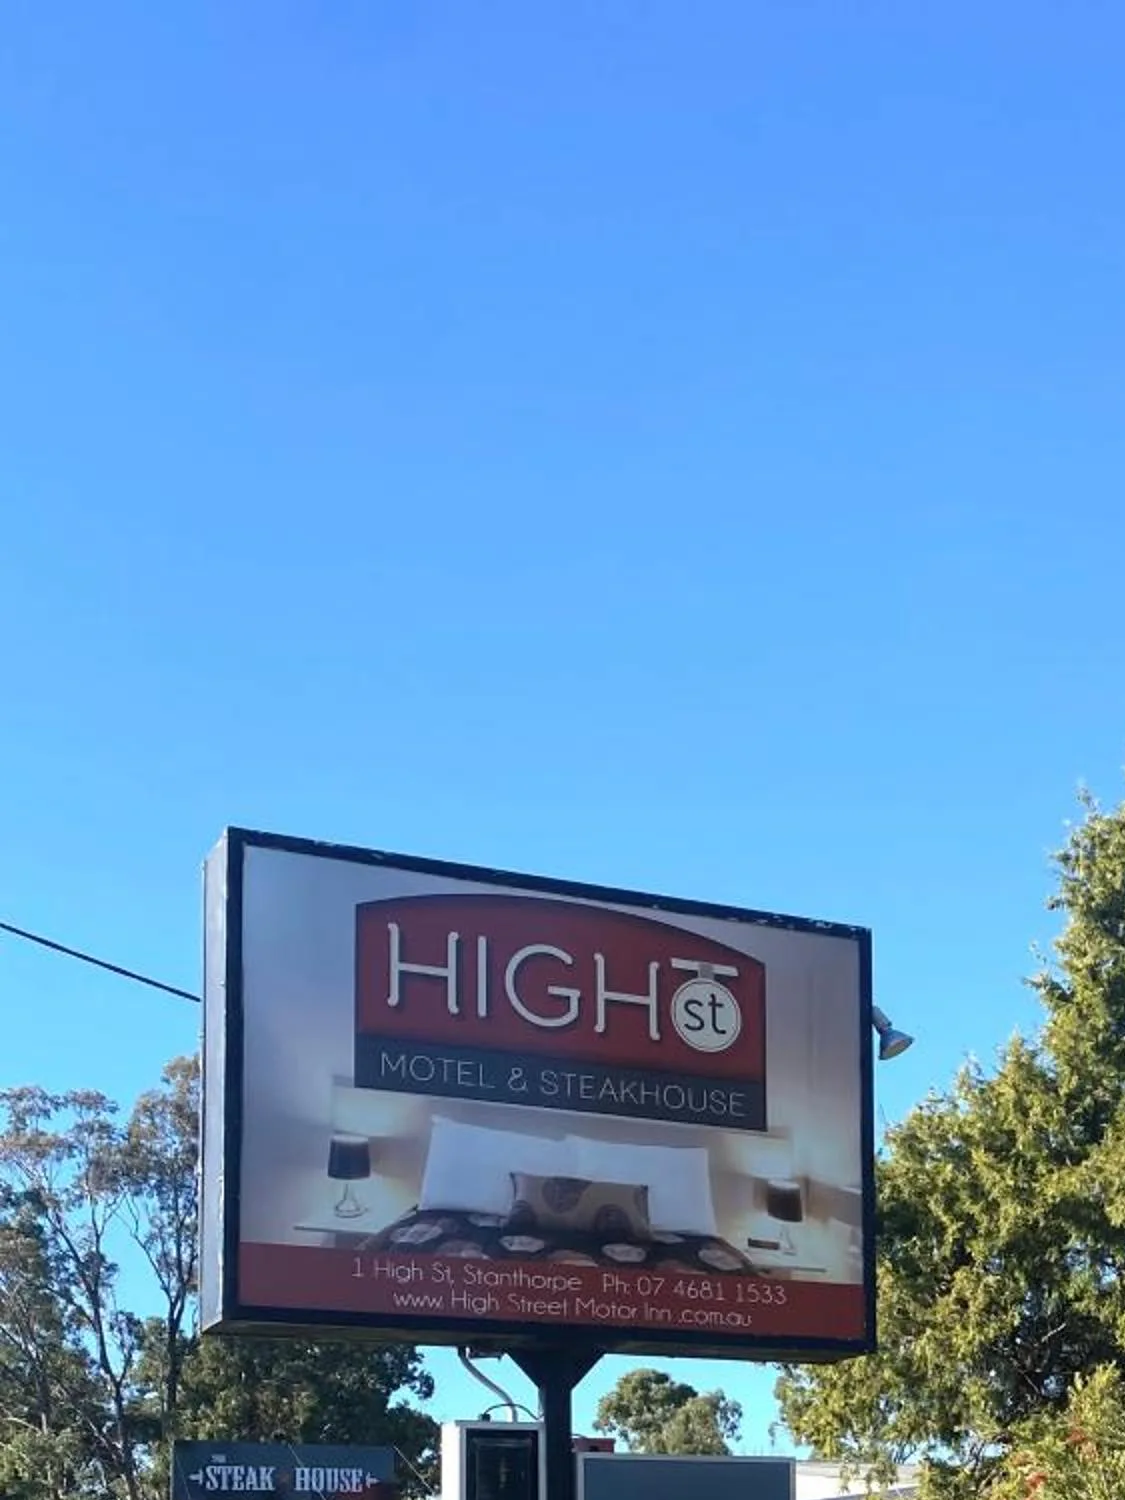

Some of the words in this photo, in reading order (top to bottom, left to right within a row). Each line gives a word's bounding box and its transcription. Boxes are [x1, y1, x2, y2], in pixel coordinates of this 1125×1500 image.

[387, 922, 661, 1041] HIGH
[683, 993, 727, 1035] st
[380, 1051, 496, 1089] MOTEL
[507, 1066, 529, 1092] &
[540, 1070, 746, 1118] STEAKHOUSE
[352, 1257, 364, 1278] 1
[374, 1259, 423, 1283] High
[463, 1263, 583, 1294] Stanthorpe
[637, 1276, 665, 1297] 07
[673, 1280, 726, 1301] 4681
[736, 1283, 787, 1304] 1533
[451, 1289, 500, 1315] High
[507, 1293, 568, 1317] Street
[575, 1297, 637, 1320] Motor
[644, 1302, 673, 1322] Inn
[205, 1465, 276, 1491] STEAK
[294, 1467, 363, 1492] HOUSE
